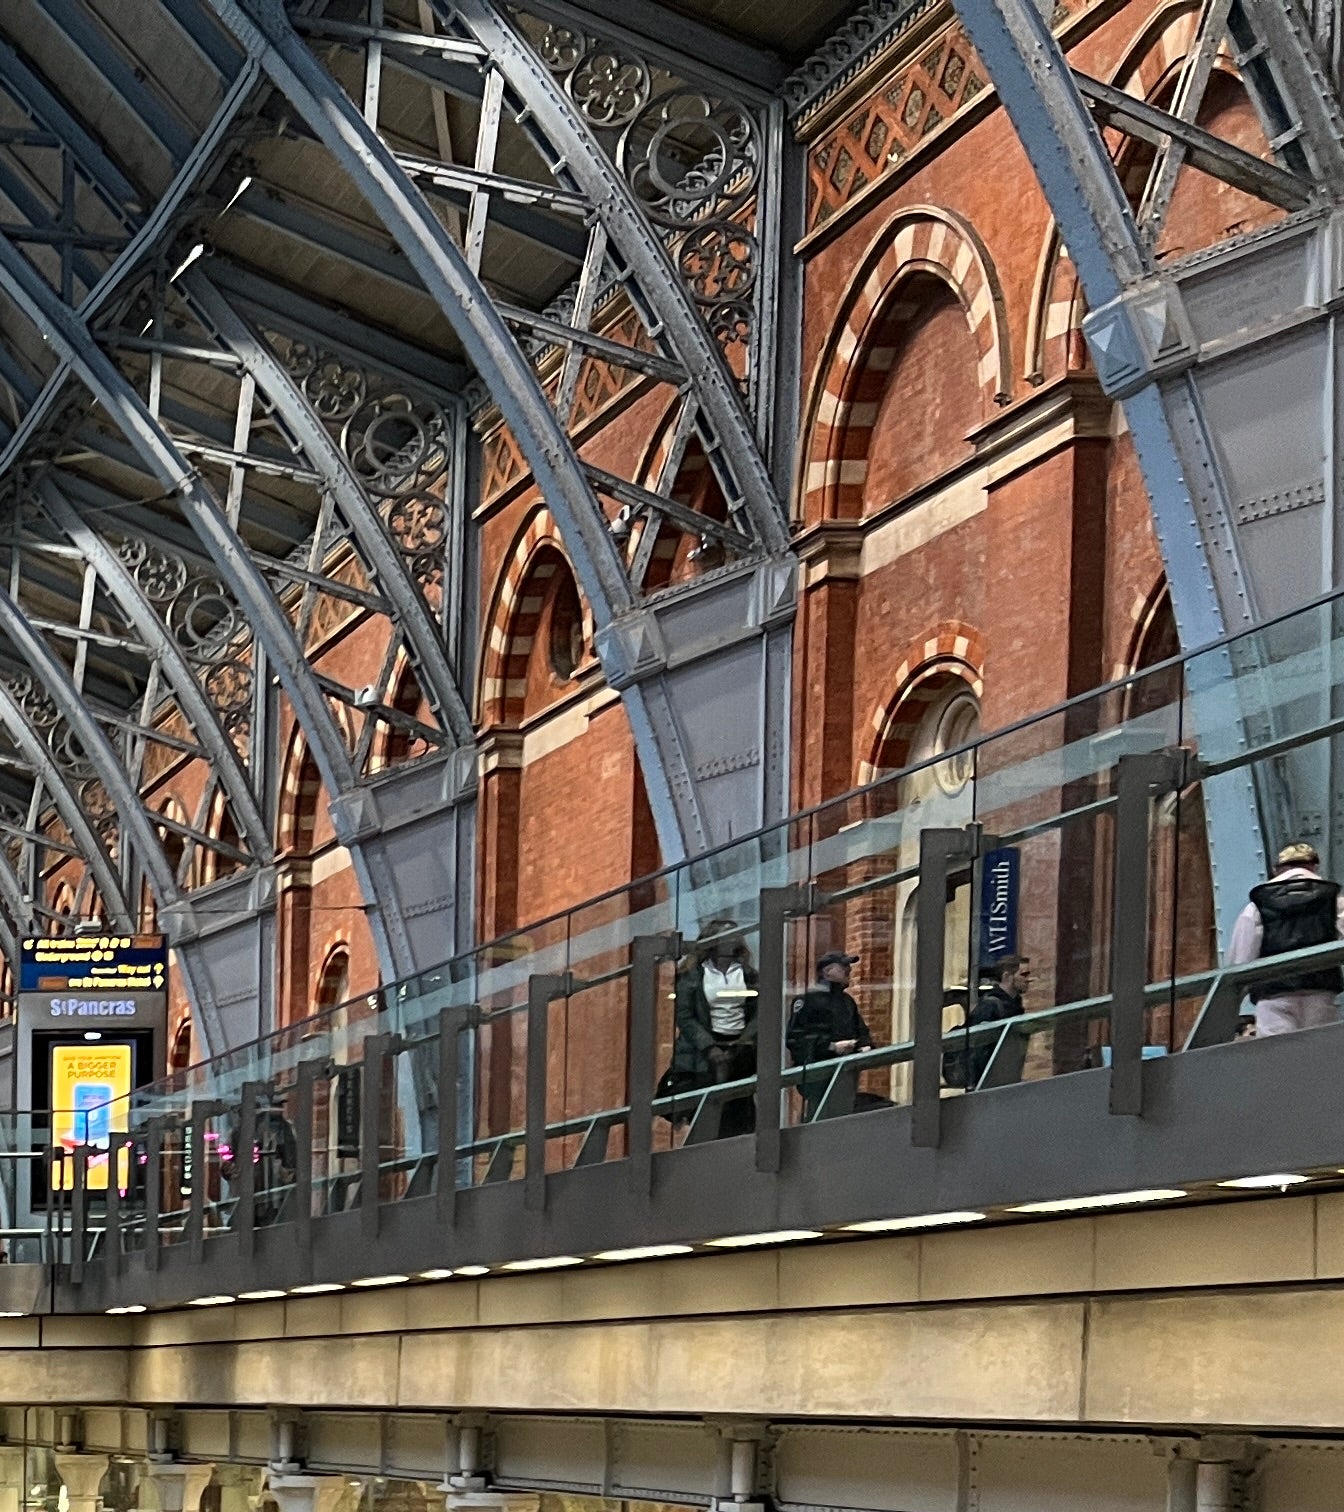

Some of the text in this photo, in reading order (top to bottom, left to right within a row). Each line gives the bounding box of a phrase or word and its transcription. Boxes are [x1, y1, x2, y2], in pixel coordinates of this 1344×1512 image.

[988, 860, 1010, 953] WHSmith
[78, 1062, 116, 1070] BIGGER
[67, 1070, 116, 1079] PURPOSE
